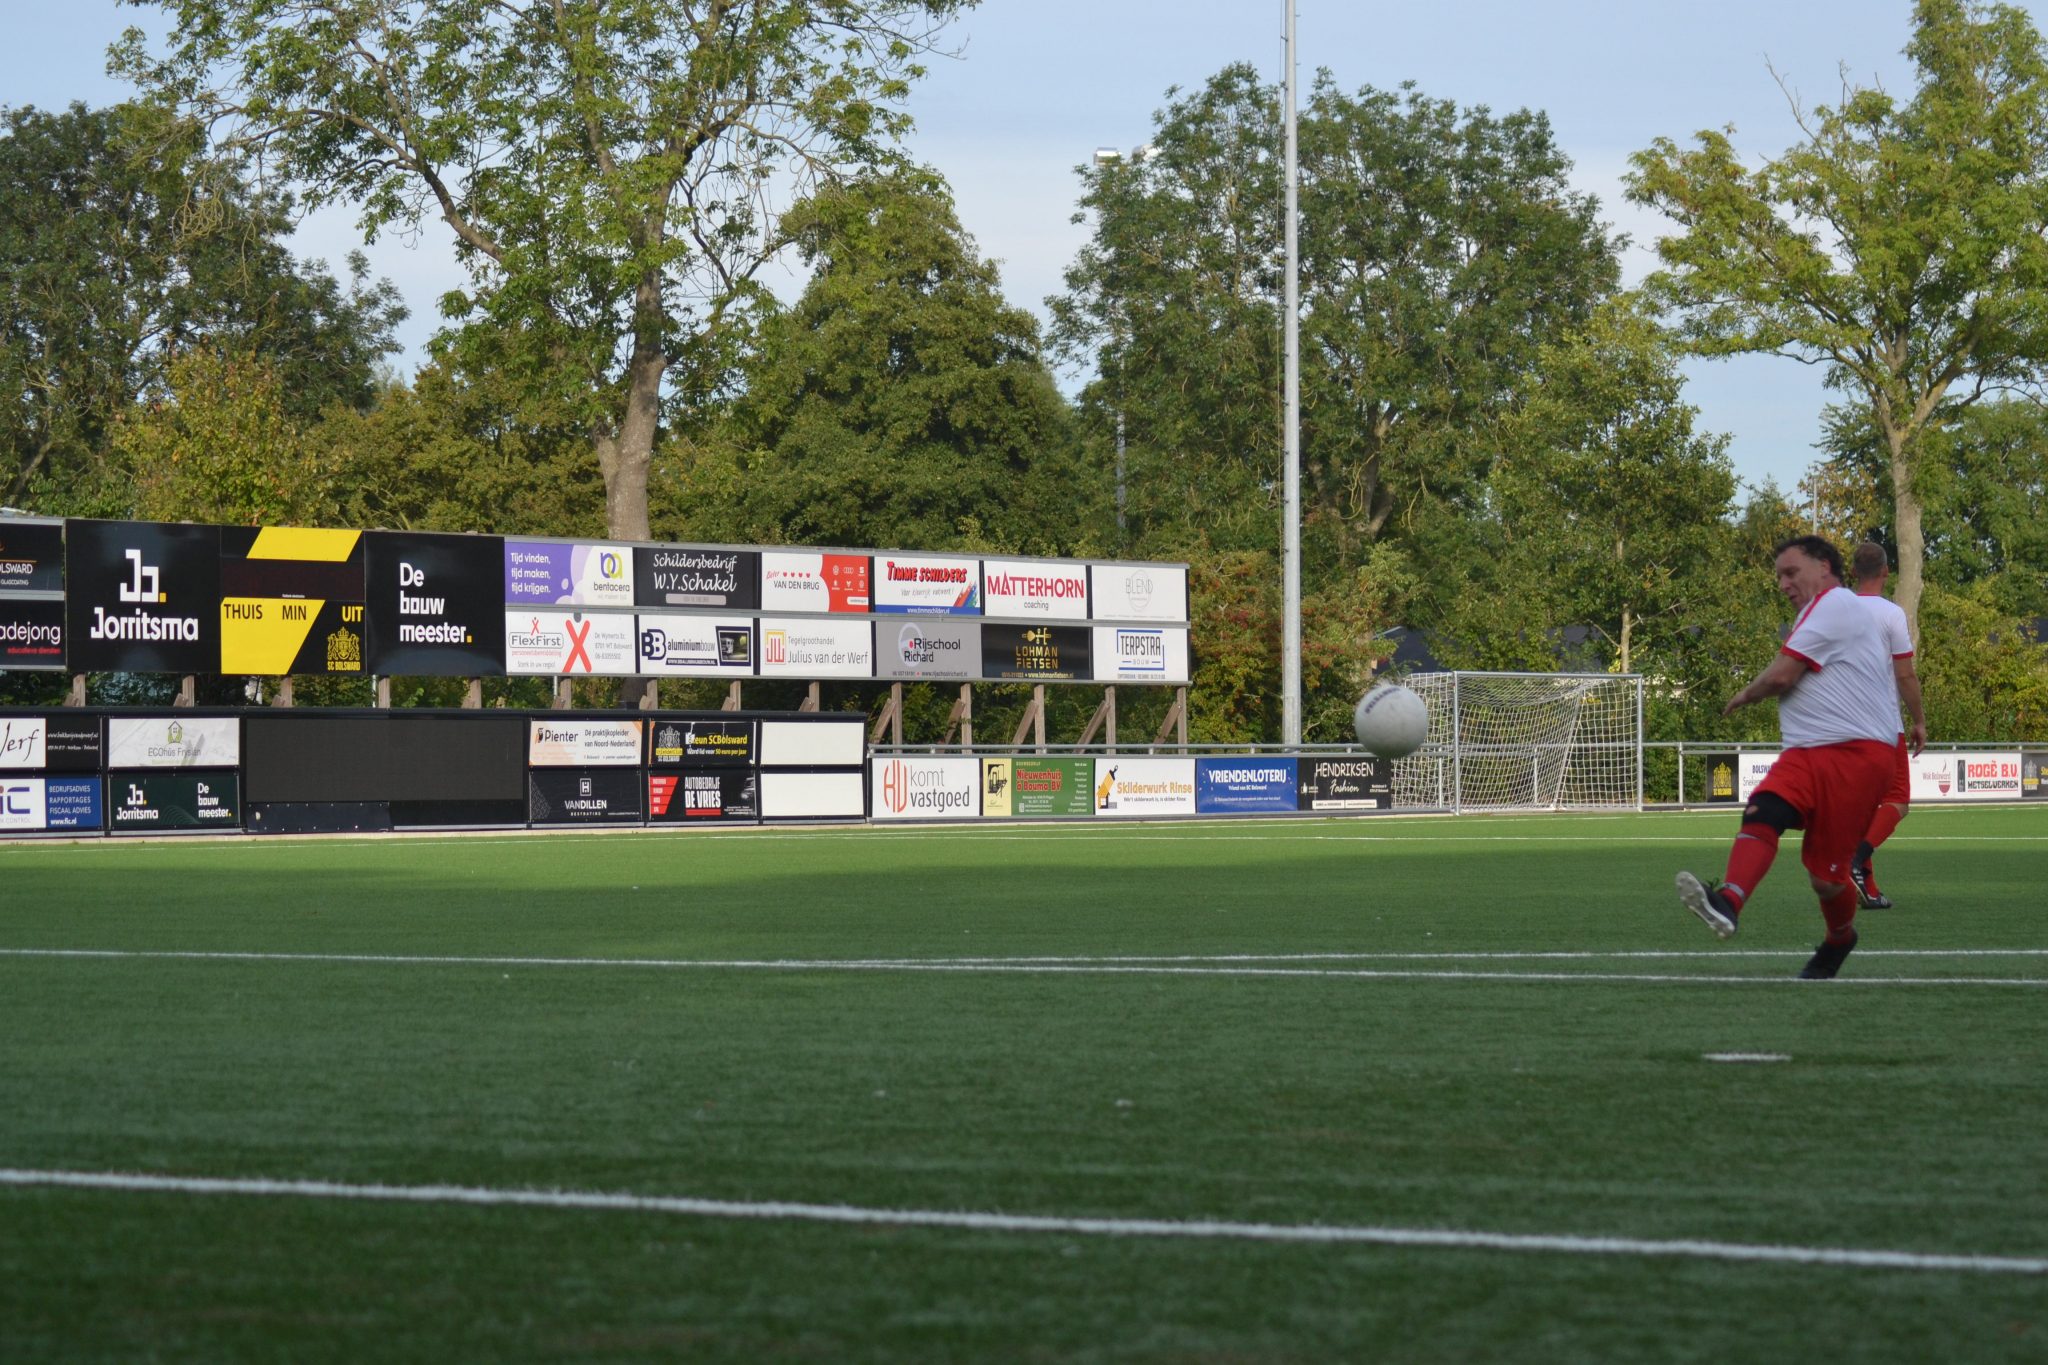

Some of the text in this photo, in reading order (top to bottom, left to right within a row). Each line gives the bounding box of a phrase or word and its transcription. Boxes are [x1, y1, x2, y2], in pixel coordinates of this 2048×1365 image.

[511, 552, 551, 564] Tijd vinden,
[653, 552, 738, 574] Schildersbedrijf
[400, 562, 424, 587] De
[512, 568, 551, 580] tijd maken,
[512, 582, 551, 595] tijd krijgen.
[773, 581, 820, 590] VAN DEN BRUG
[987, 570, 1085, 598] MATTERHORN
[1125, 578, 1153, 594] BLEND
[400, 590, 445, 615] bouw
[1024, 601, 1049, 611] coaching
[224, 604, 263, 619] THUIS
[282, 605, 307, 620] MIN
[342, 606, 364, 622] UIT
[91, 607, 198, 640] Jorritsma
[511, 635, 561, 646] FlexFirst
[788, 636, 835, 647] Tegelgroothandel
[913, 638, 961, 652] Rijschool
[1120, 635, 1161, 655] TERPSTRA
[788, 650, 868, 664] Julius van der Werf
[904, 650, 934, 662] Richard
[1015, 646, 1058, 657] LOHMAN
[328, 661, 335, 671] SC
[1016, 658, 1058, 669] FIETSEN
[545, 729, 578, 742] Pienter
[910, 765, 945, 787] komt
[1208, 769, 1287, 783] VRIENDENLOTERIJ
[1315, 762, 1374, 777] HENDRIKSEN
[49, 785, 91, 793] BEDRIJFSADVIES
[198, 782, 210, 794] De
[685, 777, 720, 790] AUTOBEDRIJF
[1169, 783, 1193, 793] Rinse
[1330, 779, 1359, 796] Fashion
[1967, 780, 2018, 790] METSELWERKEN
[49, 796, 91, 804] RAPPORTAGES
[198, 795, 219, 806] bouw
[685, 791, 721, 809] DE VRIES
[910, 785, 970, 813] vastgoed
[116, 807, 159, 820] Jorritsma
[50, 817, 77, 825] www.fic.nl
